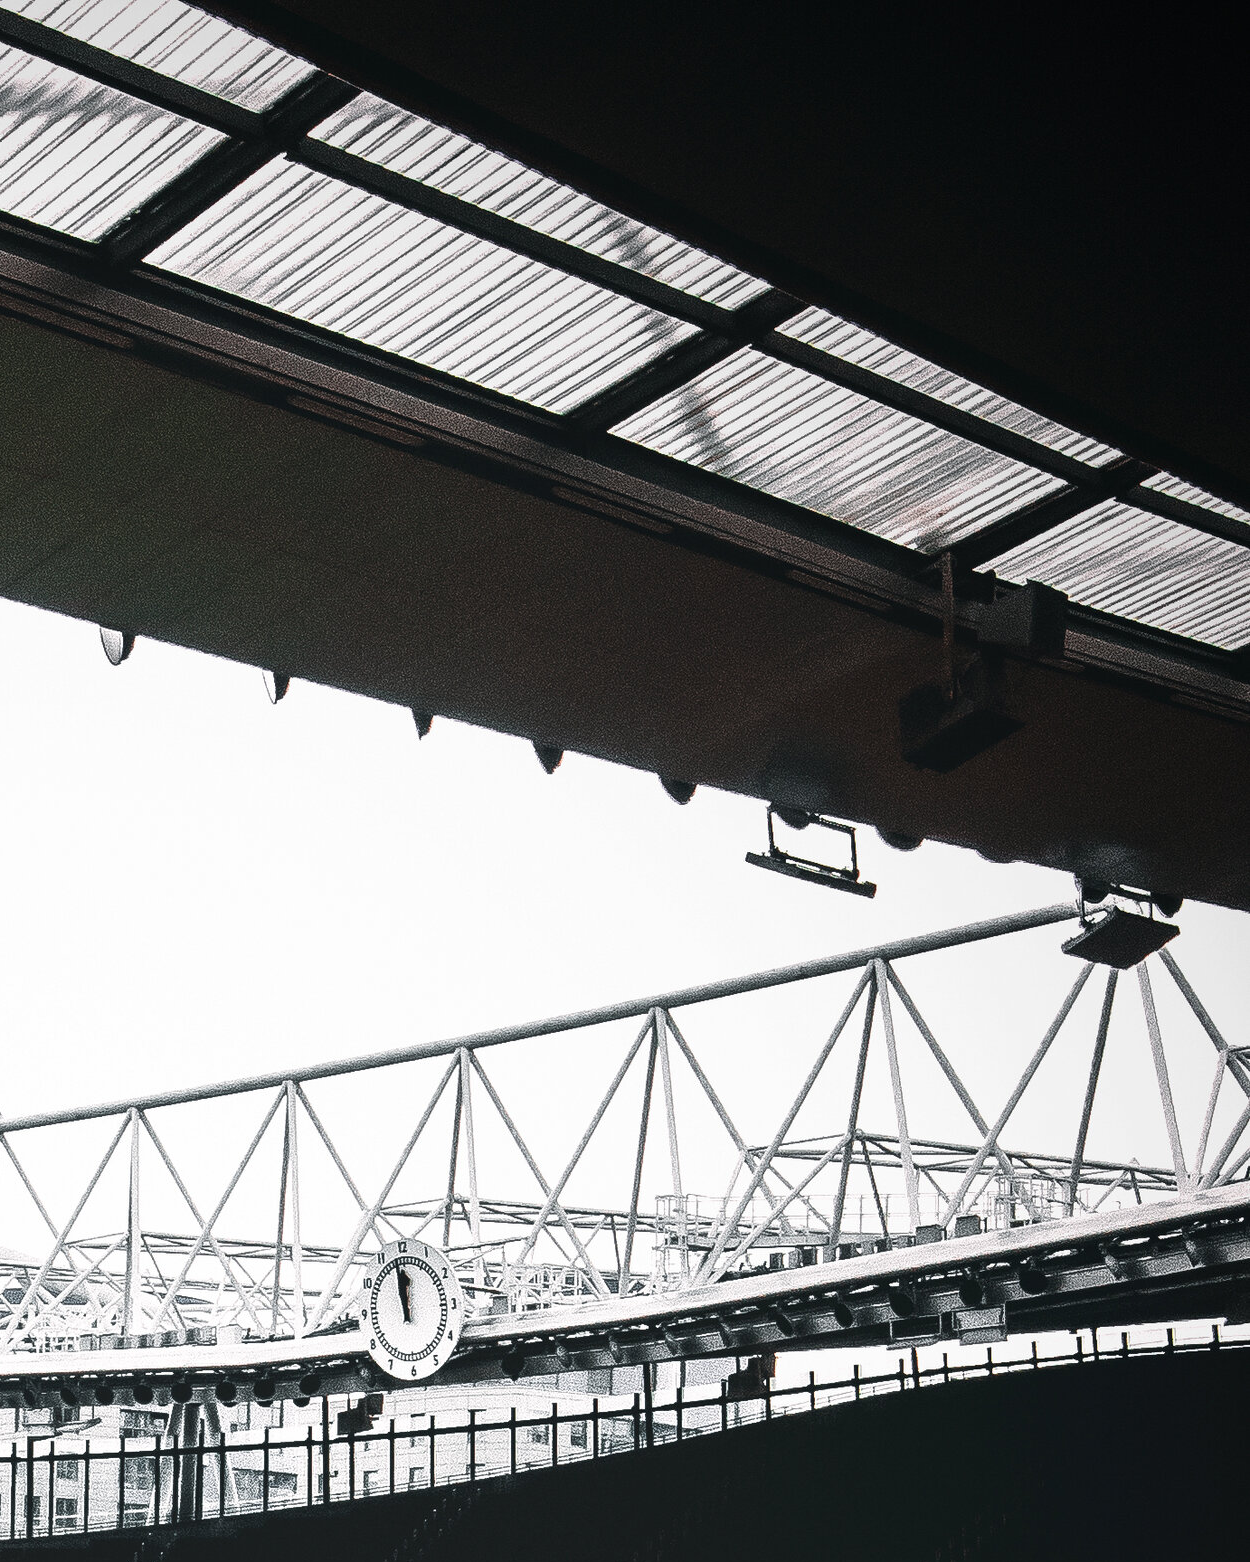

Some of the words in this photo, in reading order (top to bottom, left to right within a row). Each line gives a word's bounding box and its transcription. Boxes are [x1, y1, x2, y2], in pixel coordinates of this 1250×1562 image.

[398, 1242, 407, 1253] 12
[424, 1246, 429, 1257] 1
[377, 1253, 385, 1264] 11
[441, 1267, 449, 1279] 2
[363, 1278, 373, 1289] 10
[450, 1298, 457, 1310] 3
[361, 1309, 368, 1320] 9
[448, 1330, 454, 1341] 4
[370, 1338, 377, 1349] 8
[388, 1359, 393, 1370] 7
[433, 1354, 439, 1366] 5
[411, 1365, 417, 1376] 6
